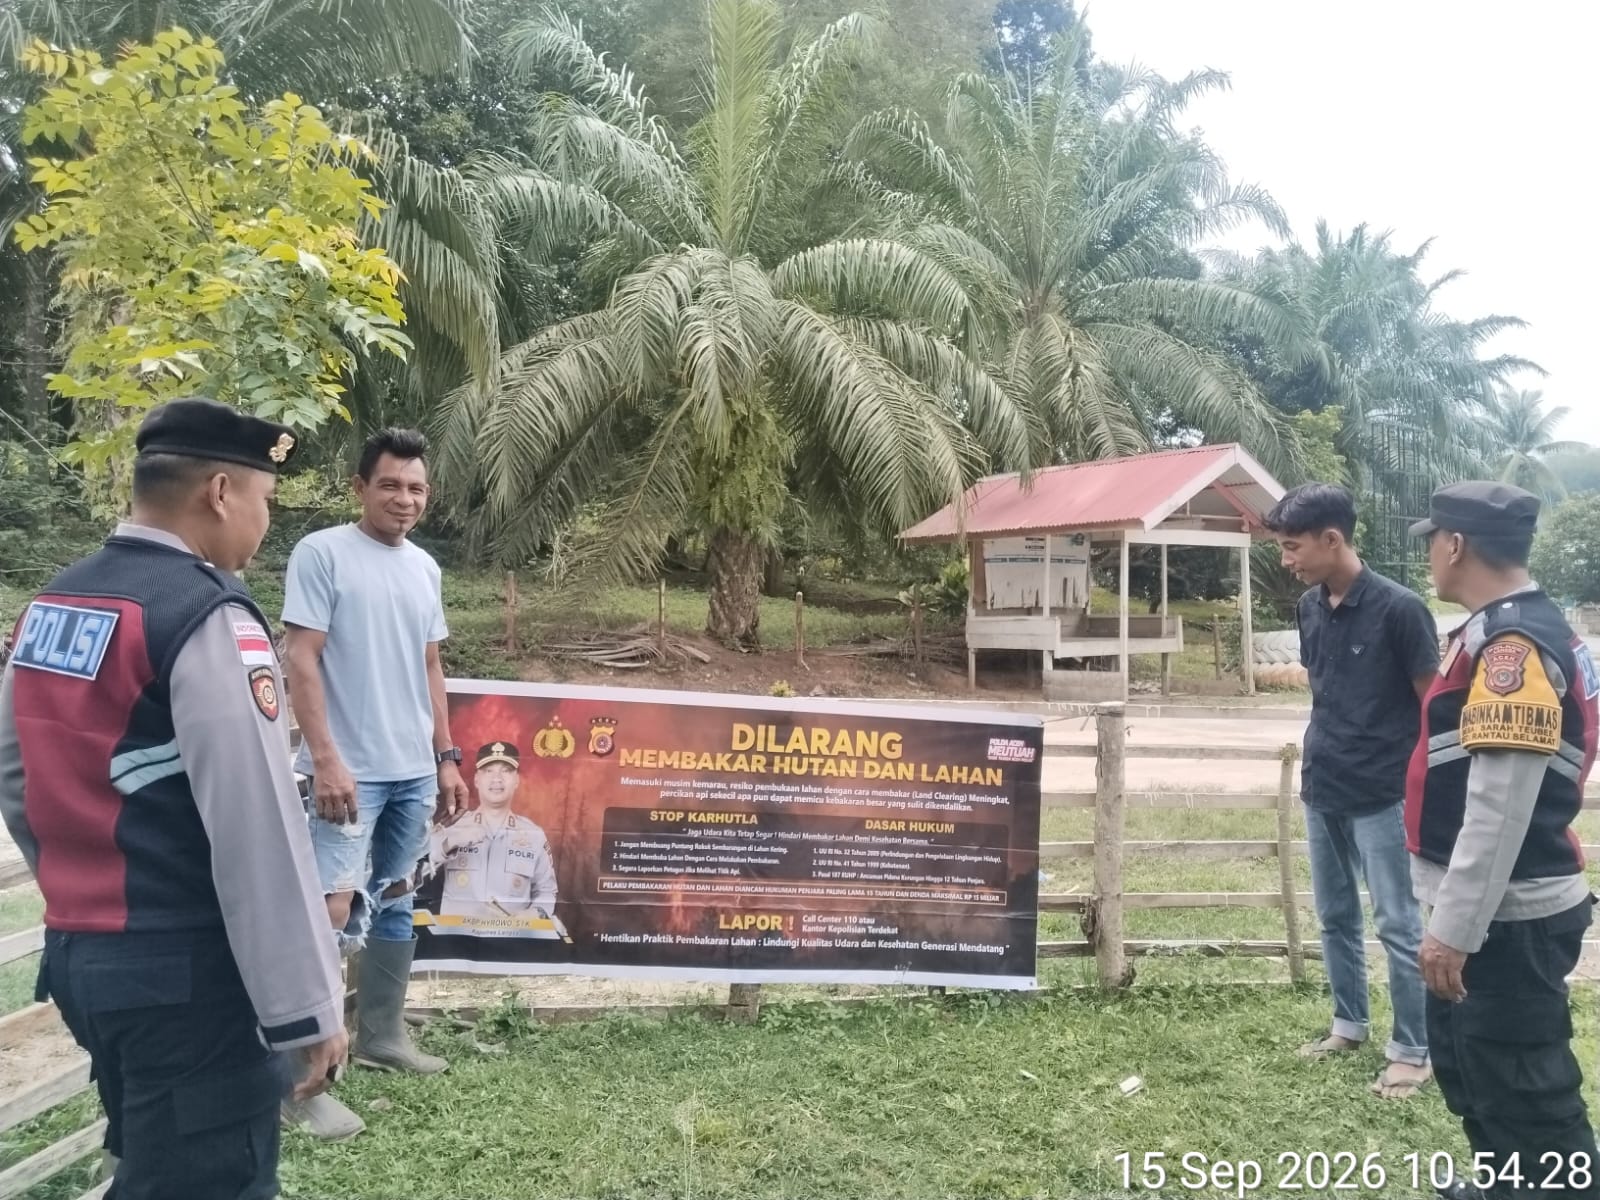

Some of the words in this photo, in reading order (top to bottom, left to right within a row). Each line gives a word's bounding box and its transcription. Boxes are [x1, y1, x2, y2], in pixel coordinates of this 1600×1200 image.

[16, 606, 111, 673] POLISI
[1480, 723, 1513, 732] SARAH
[731, 723, 903, 760] DILARANG
[1472, 732, 1510, 740] RANTAU
[618, 748, 766, 773] MEMBAKAR
[773, 755, 857, 779] HUTAN
[863, 760, 914, 781] DAN
[921, 763, 1003, 787] LAHAN
[620, 777, 662, 787] Memasuki
[664, 778, 690, 788] musim
[692, 780, 728, 790] kemarau,
[730, 781, 753, 790] resiko
[755, 782, 799, 794] pembukaan
[801, 784, 822, 793] lahan
[824, 786, 853, 797] dengan
[871, 788, 910, 798] membakar
[912, 789, 933, 800] (Land
[934, 791, 967, 802] Clearing)
[969, 793, 1010, 805] Meningkat,
[659, 789, 694, 799] percikan
[695, 790, 708, 800] api
[710, 791, 735, 800] sekecil
[737, 793, 751, 802] apa
[753, 794, 769, 802] pun
[770, 793, 792, 804] dapat
[794, 795, 825, 804] memicu
[826, 797, 864, 806] kebakaran
[866, 798, 885, 807] besar
[887, 801, 905, 810] yang
[907, 800, 923, 809] sulit
[924, 801, 973, 811] dikendalikan.
[650, 810, 684, 822] STOP
[687, 811, 758, 825] KARHUTLA
[865, 819, 905, 831] DASAR
[909, 822, 955, 834] HUKUM
[687, 828, 702, 837] Jaga
[724, 829, 736, 837] Kita
[738, 830, 755, 839] Tetap
[756, 830, 774, 840] Segar
[802, 832, 834, 841] Membakar
[835, 833, 854, 841] Lahan
[872, 835, 901, 844] Kesehatan
[508, 849, 535, 860] POLRI
[719, 914, 783, 931] LAPOR
[802, 915, 817, 924] Call
[818, 915, 842, 924] Center
[844, 916, 857, 924] 110
[859, 917, 875, 925] atau
[802, 925, 826, 933] Kantor
[828, 925, 866, 935] Kepolisian
[868, 926, 899, 935] Terdekat
[600, 933, 641, 944] Hentikan
[642, 934, 674, 944] Praktik
[675, 935, 729, 946] Pembakaran
[731, 937, 757, 946] Lahan
[763, 937, 800, 949] Lindungi
[801, 938, 833, 948] Kualitas
[835, 939, 859, 949] Udara
[861, 939, 876, 949] dan
[878, 940, 920, 950] Kesehatan
[921, 941, 957, 952] Generasi
[959, 944, 1005, 955] Mendatang
